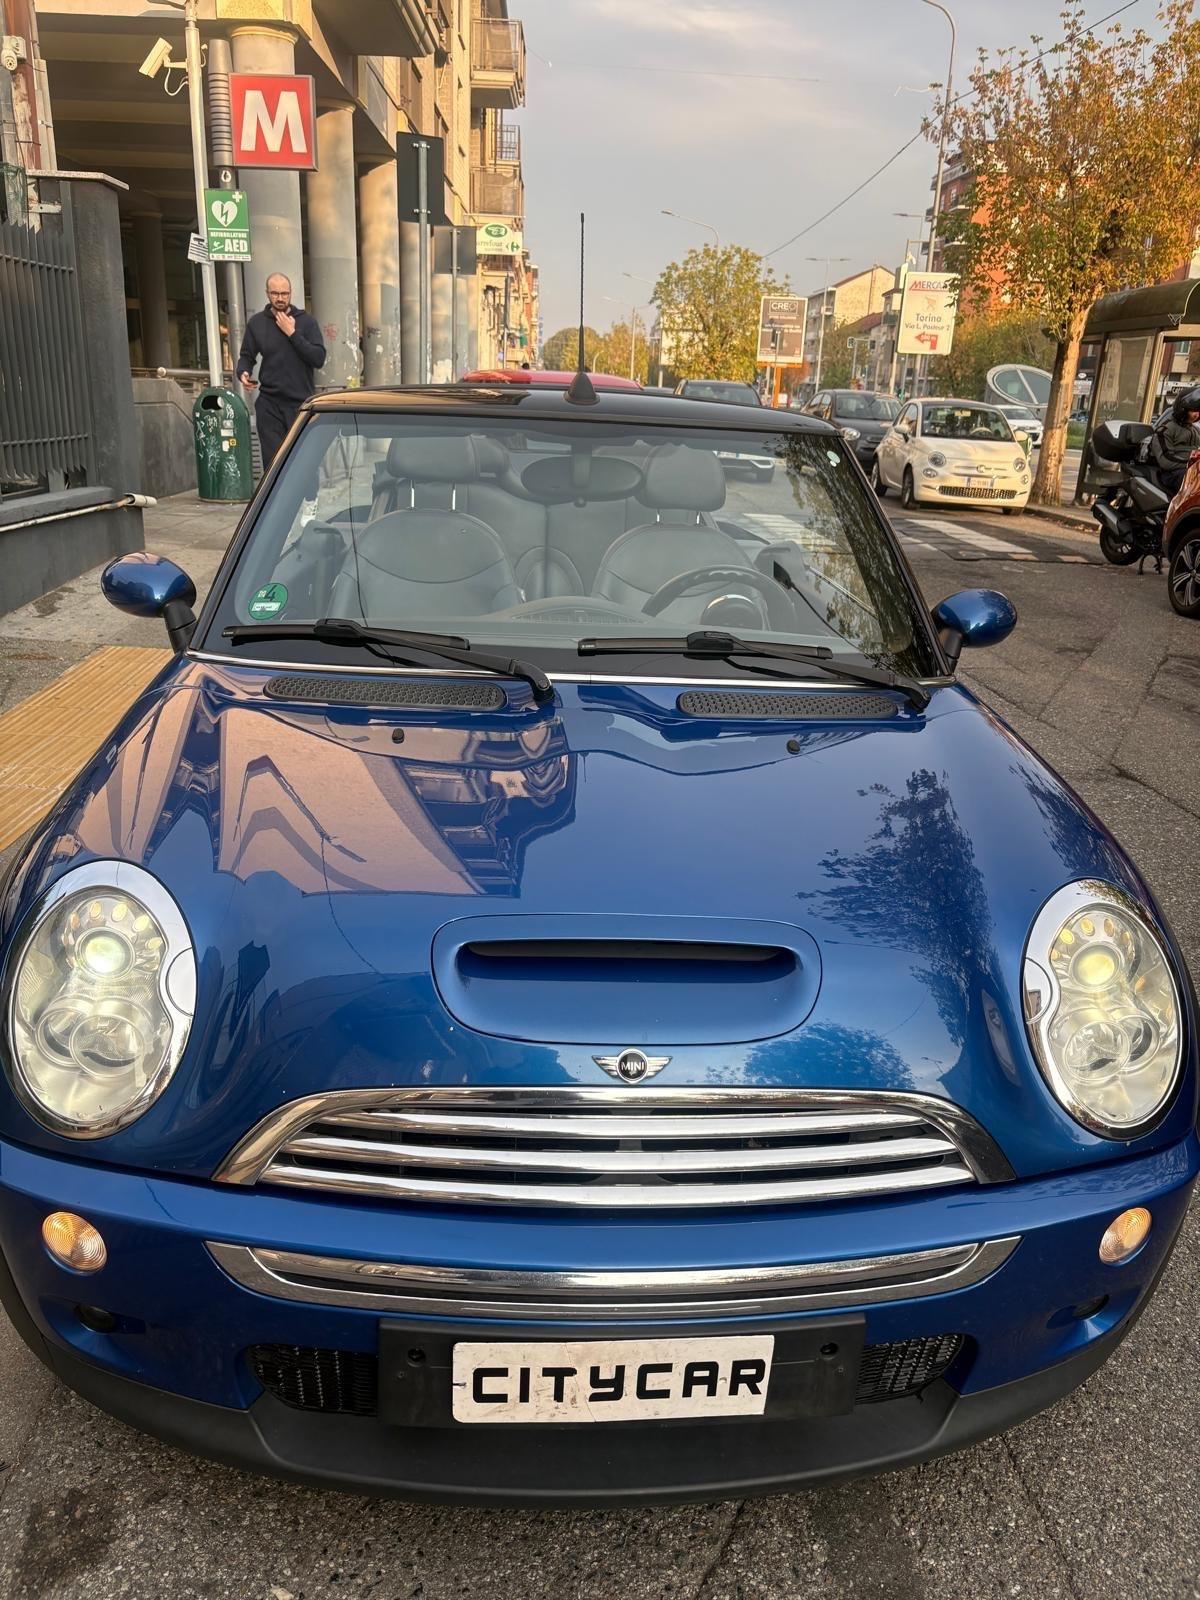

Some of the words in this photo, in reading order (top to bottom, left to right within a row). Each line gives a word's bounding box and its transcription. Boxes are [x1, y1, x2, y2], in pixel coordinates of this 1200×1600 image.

[240, 89, 308, 153] M
[224, 238, 248, 252] AED
[916, 313, 942, 323] Torino
[621, 1061, 645, 1071] MINI
[472, 1358, 766, 1403] CITYCAR
